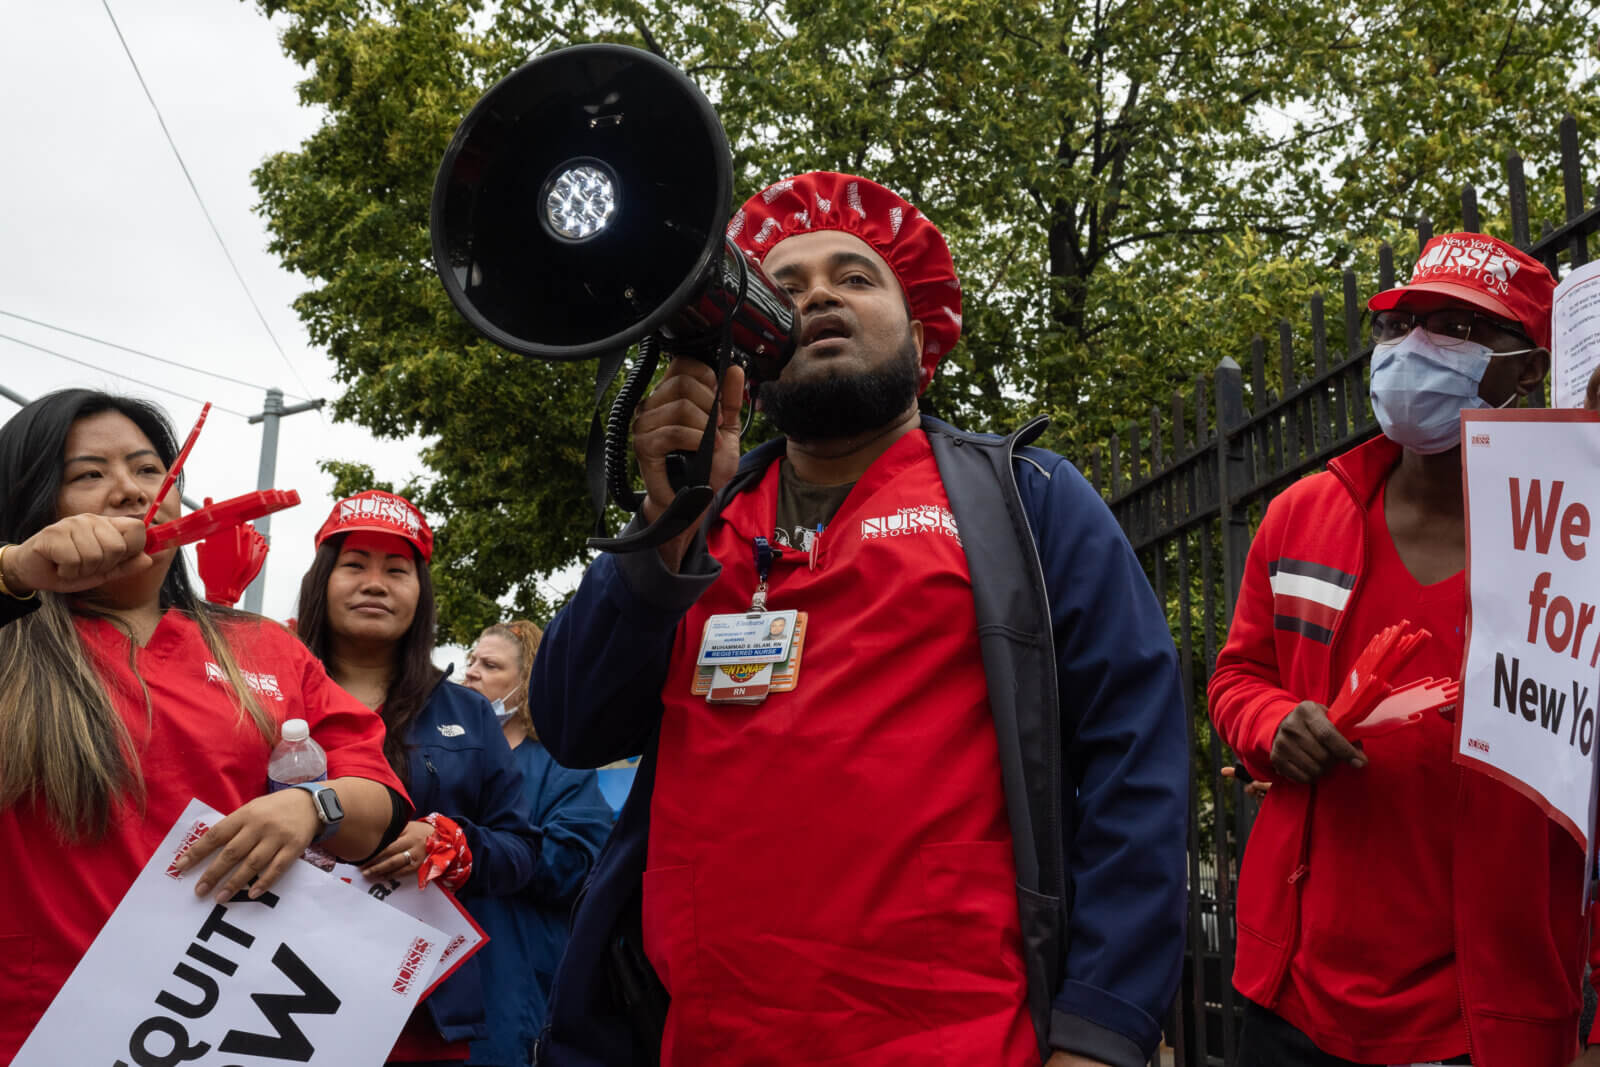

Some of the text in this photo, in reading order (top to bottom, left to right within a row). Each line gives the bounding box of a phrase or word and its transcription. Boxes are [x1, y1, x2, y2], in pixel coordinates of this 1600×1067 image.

[1509, 477, 1591, 561] We
[1527, 571, 1596, 660] for
[733, 688, 746, 696] RN
[1493, 651, 1594, 757] New Yo
[113, 874, 281, 1067] QUITY
[392, 938, 429, 994] NURSES
